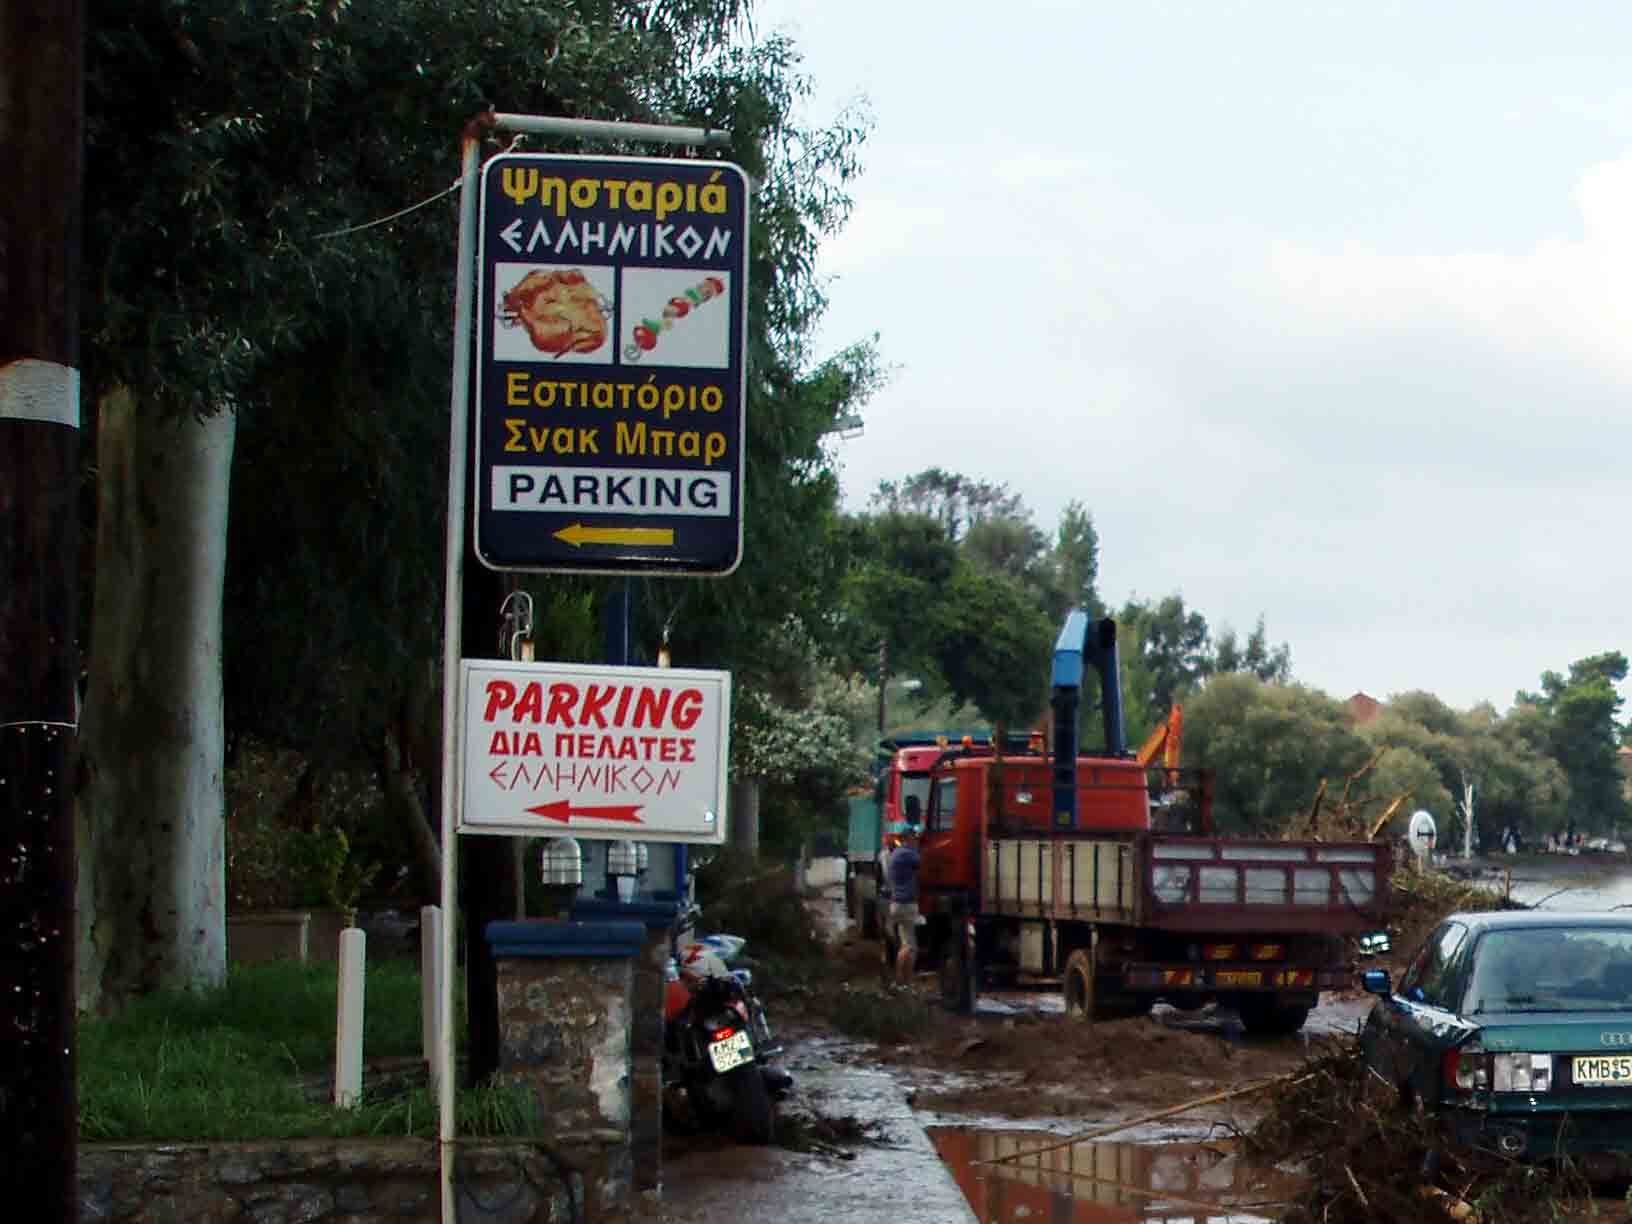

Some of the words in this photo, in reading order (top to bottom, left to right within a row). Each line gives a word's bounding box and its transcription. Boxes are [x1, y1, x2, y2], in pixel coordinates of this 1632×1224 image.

[502, 167, 728, 221] Ψησταριά
[499, 218, 732, 260] ΕΛΛΗΝΙΚΟΝ
[506, 370, 725, 419] Εστιατόριο
[504, 418, 600, 455] Σνακ
[614, 420, 728, 466] Μπαρ
[509, 473, 719, 510] PARKING
[483, 679, 704, 731] PARKING
[489, 730, 544, 758] ΔΙΑ
[554, 732, 697, 763] ΠΕΛΑΤΕΣ
[488, 760, 682, 796] ΕΛΛΗΝΙΚΟΝ
